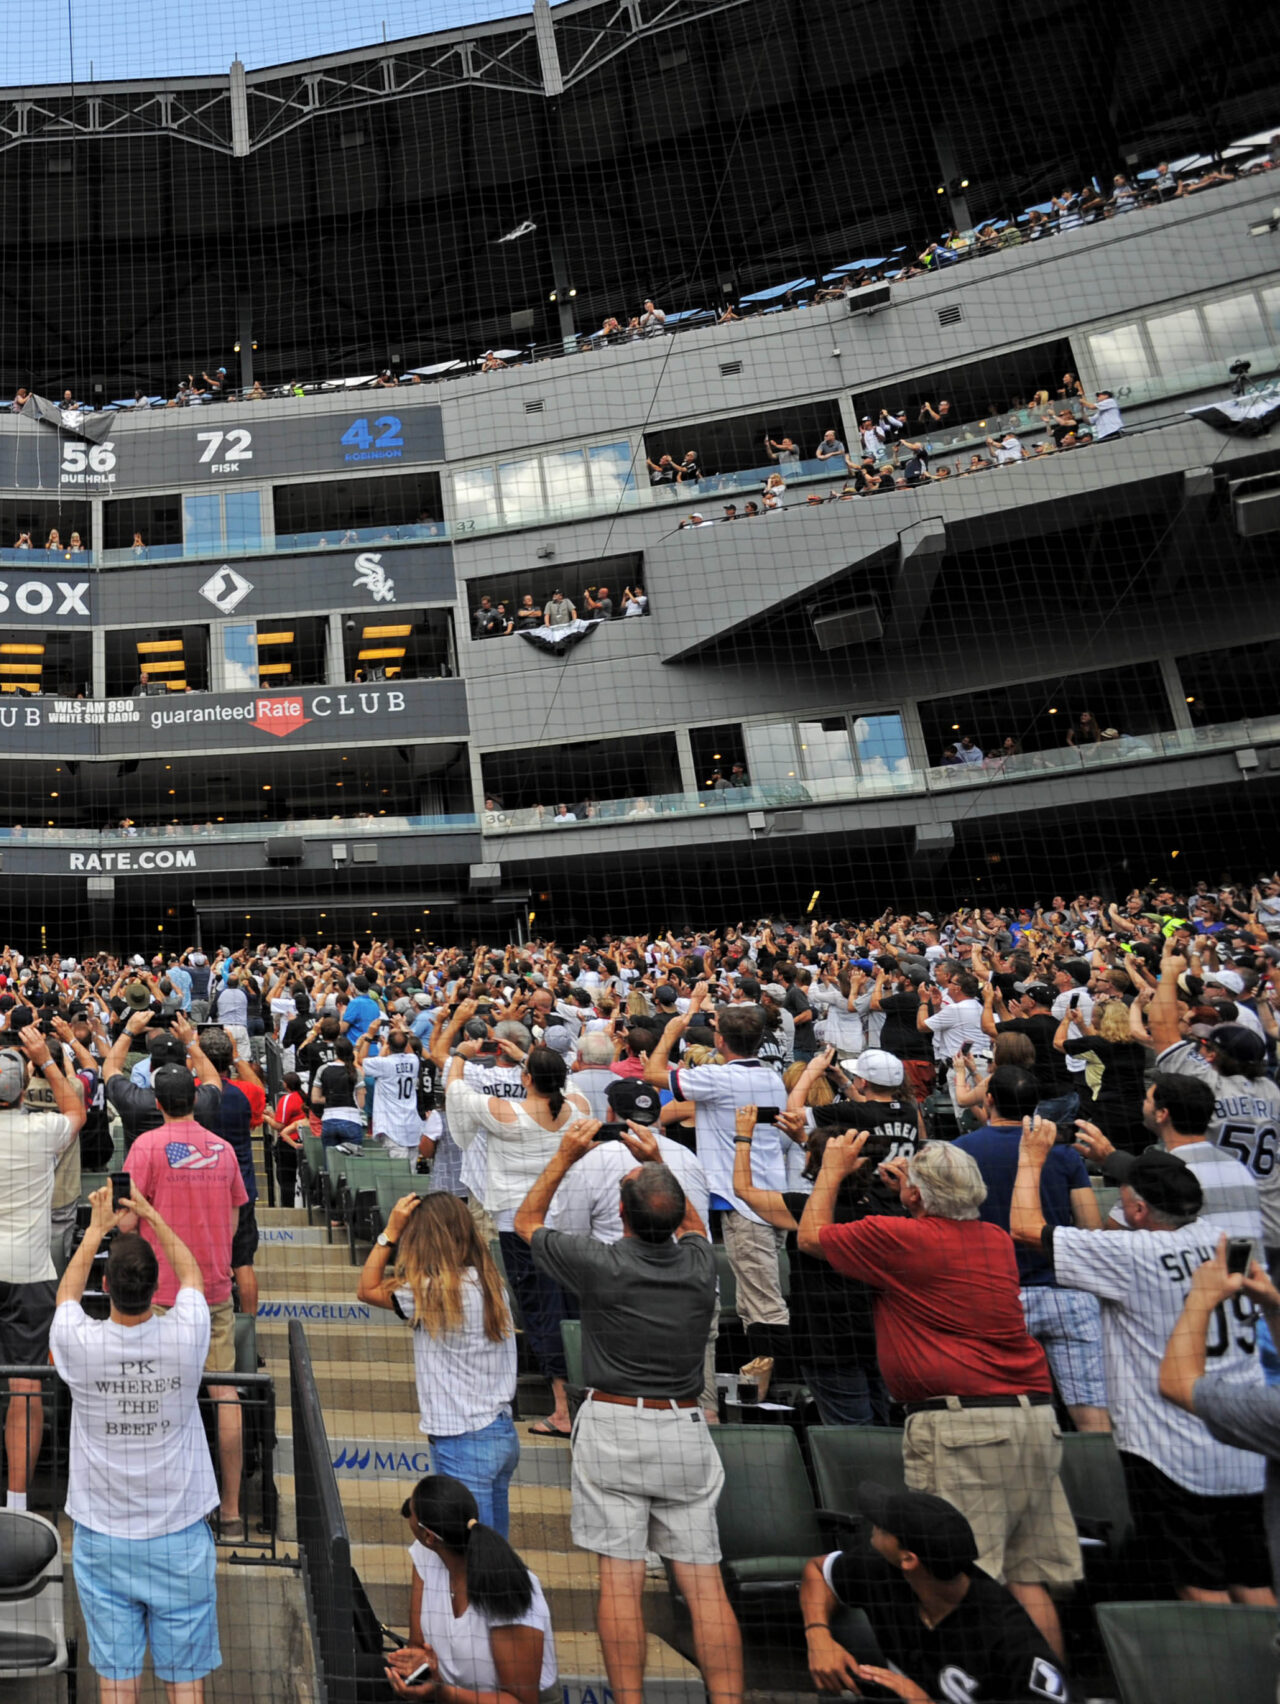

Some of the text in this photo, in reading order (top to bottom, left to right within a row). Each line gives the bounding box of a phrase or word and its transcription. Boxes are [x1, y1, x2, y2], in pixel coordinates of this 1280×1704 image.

[340, 415, 405, 450] 42
[197, 428, 252, 464] 72
[61, 441, 117, 473] 56
[344, 448, 403, 462] ROBINSON
[211, 464, 239, 474] FISK
[60, 472, 116, 484] BUEHRLE
[55, 700, 134, 714] WLS-AM 890
[151, 692, 406, 729] guaranteed Rate CLUB
[48, 711, 140, 724] WHITE SOX RADIO
[69, 850, 197, 871] RATE.COM
[28, 1088, 54, 1101] FIS
[398, 1077, 412, 1100] 10
[1218, 1122, 1278, 1178] 56
[283, 1304, 370, 1319] MAGELLAN
[119, 1359, 156, 1376] PK
[95, 1376, 182, 1394] WHERE'S
[118, 1399, 159, 1414] THE
